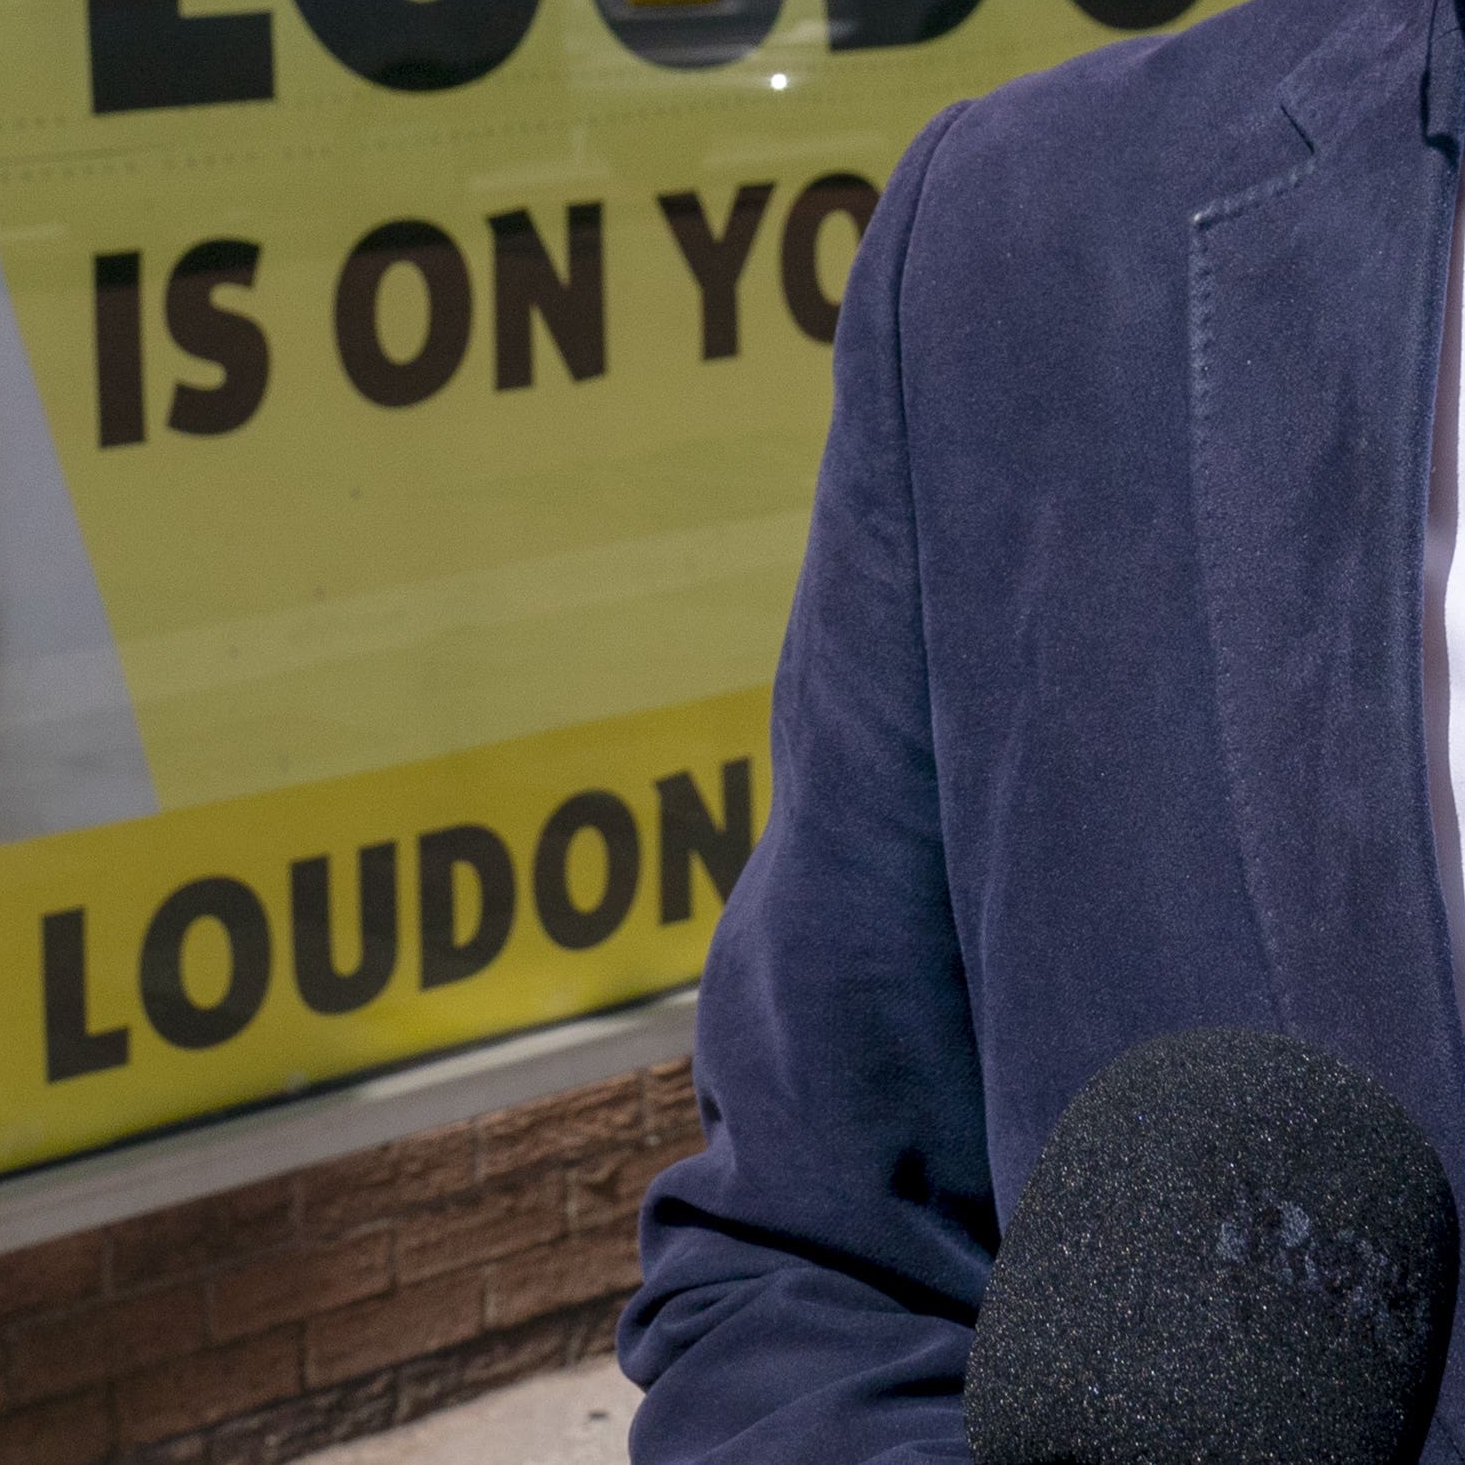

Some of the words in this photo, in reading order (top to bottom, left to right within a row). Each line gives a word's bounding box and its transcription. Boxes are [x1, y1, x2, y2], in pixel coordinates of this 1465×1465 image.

[92, 238, 271, 449] IS
[334, 200, 607, 409] ON
[40, 755, 754, 1085] LOUDON
